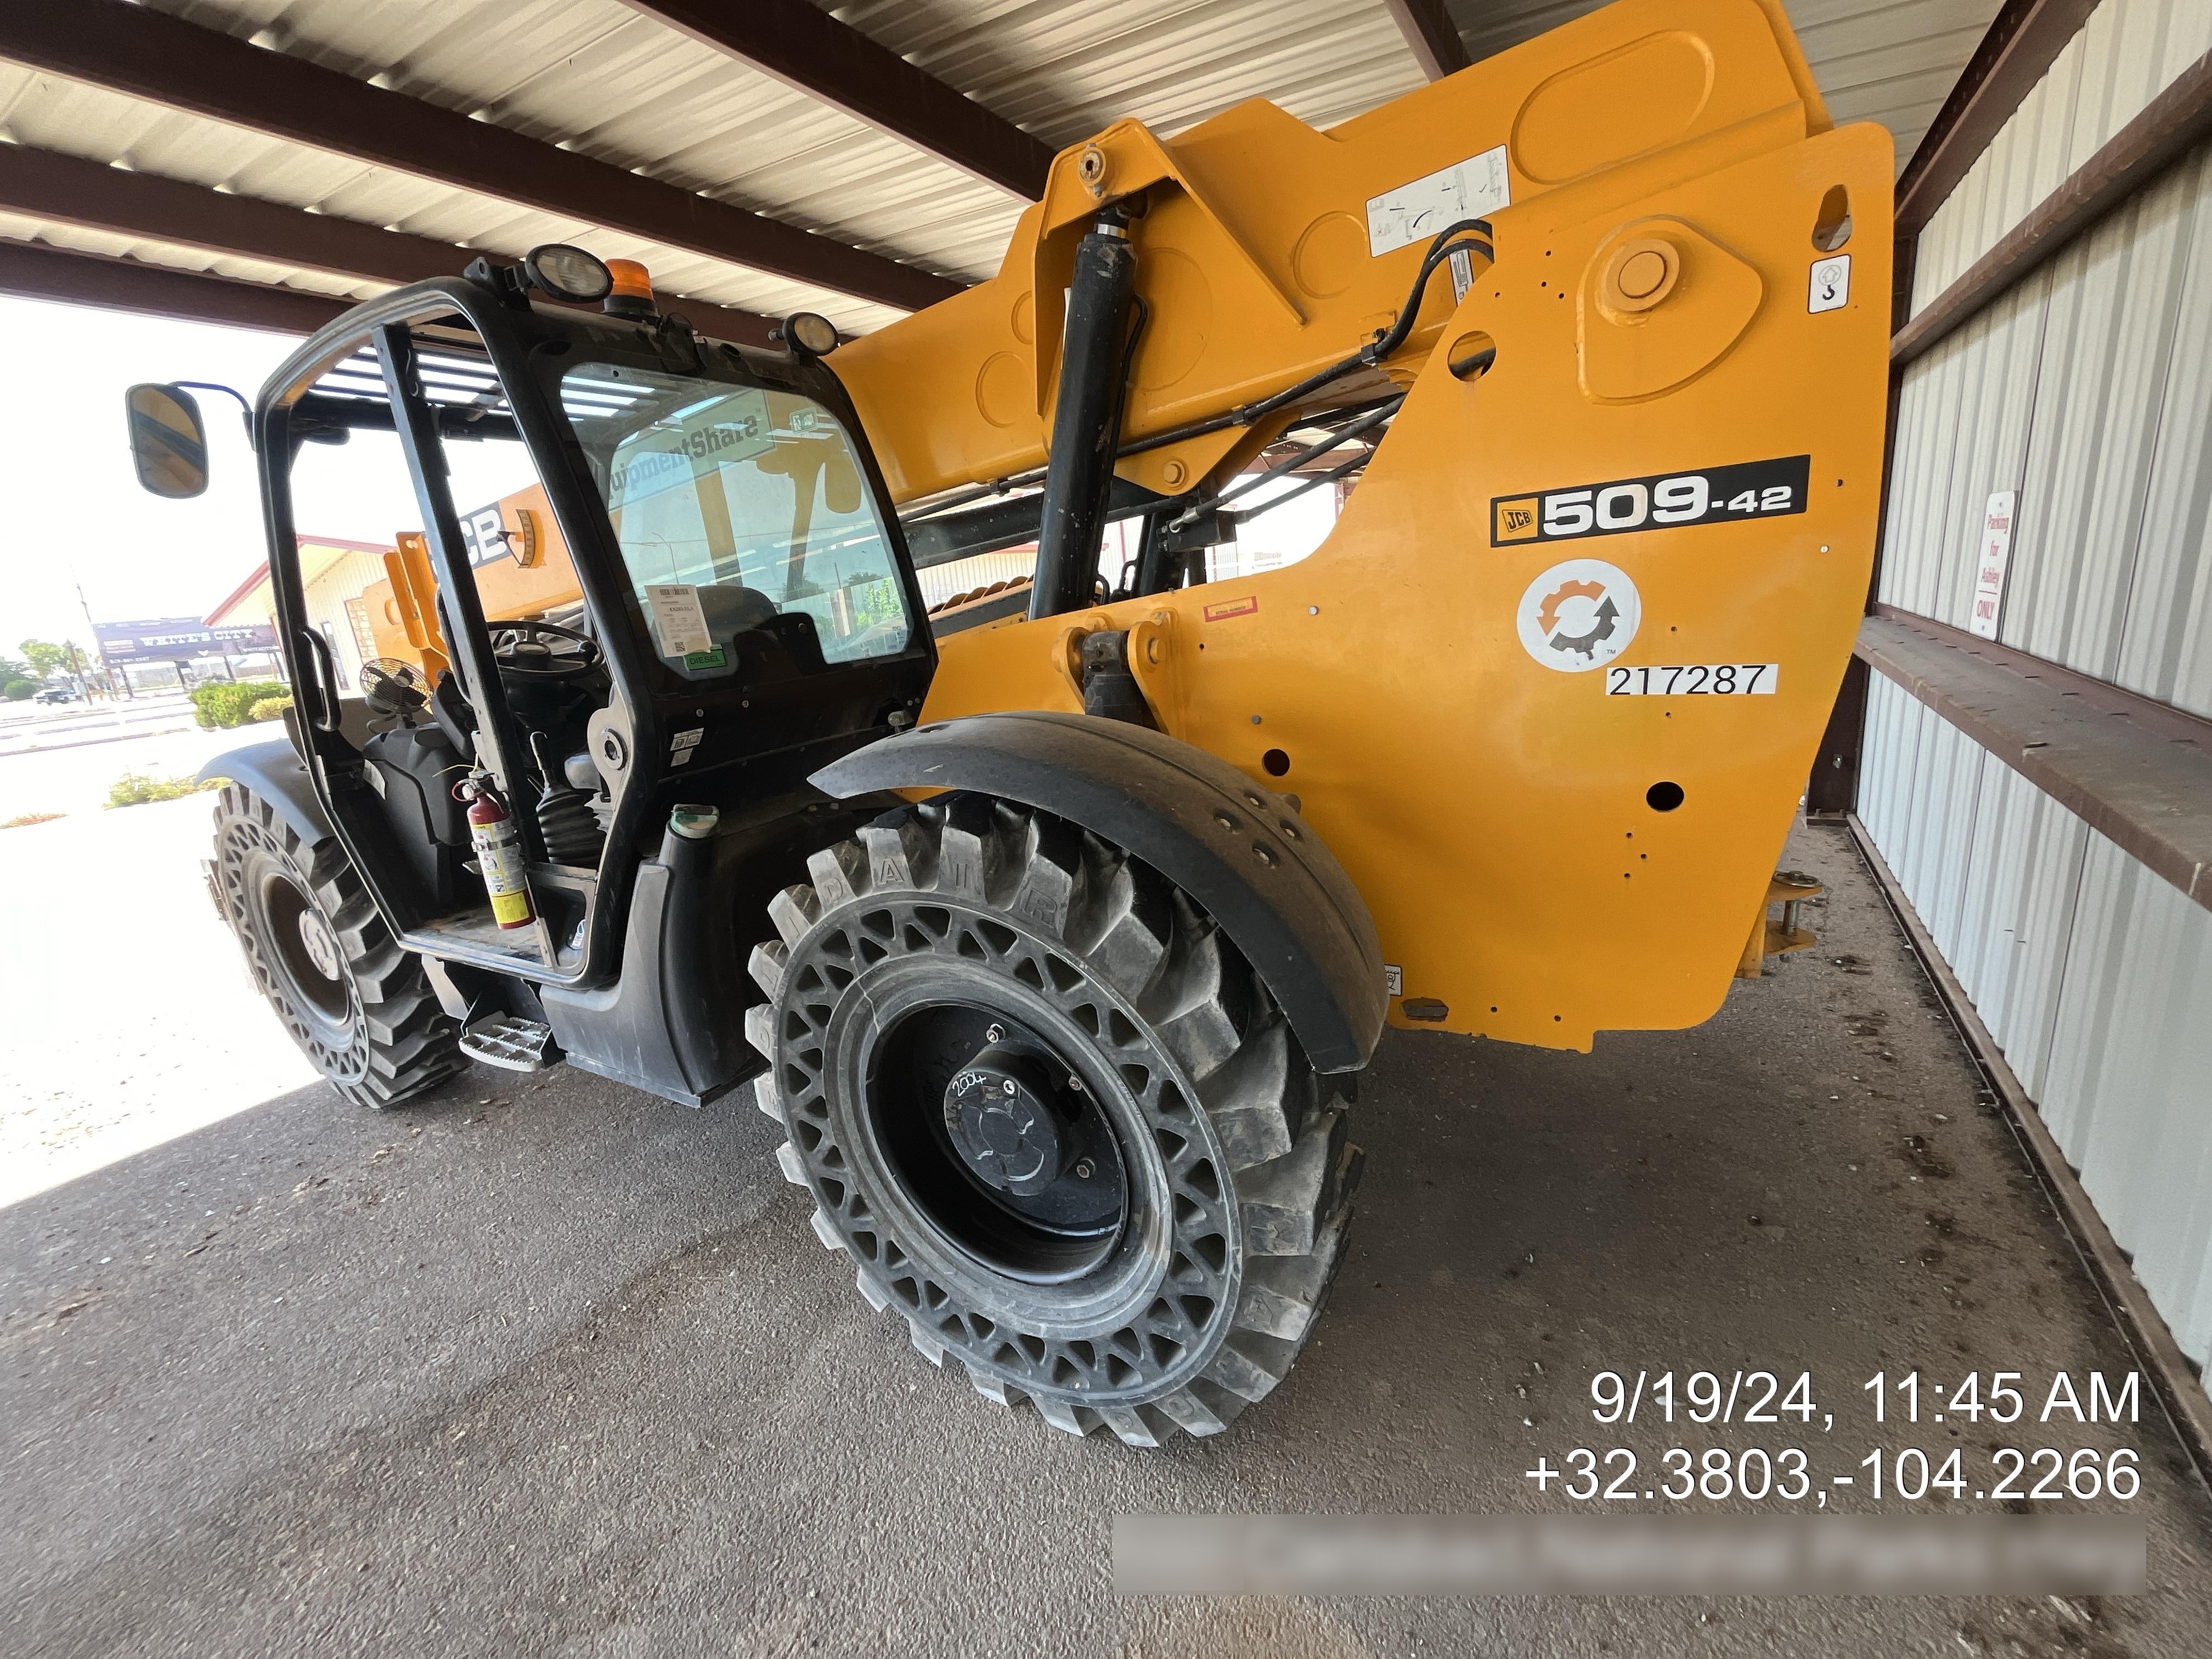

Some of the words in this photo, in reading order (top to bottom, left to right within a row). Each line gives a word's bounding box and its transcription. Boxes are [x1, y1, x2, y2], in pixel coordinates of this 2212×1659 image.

[1506, 509, 1532, 530] JCB
[1543, 475, 1792, 536] 509-42
[1977, 600, 1995, 620] ONLY
[213, 629, 254, 641] CITY
[689, 654, 721, 665] DIESEL
[1610, 665, 1767, 696] 217287
